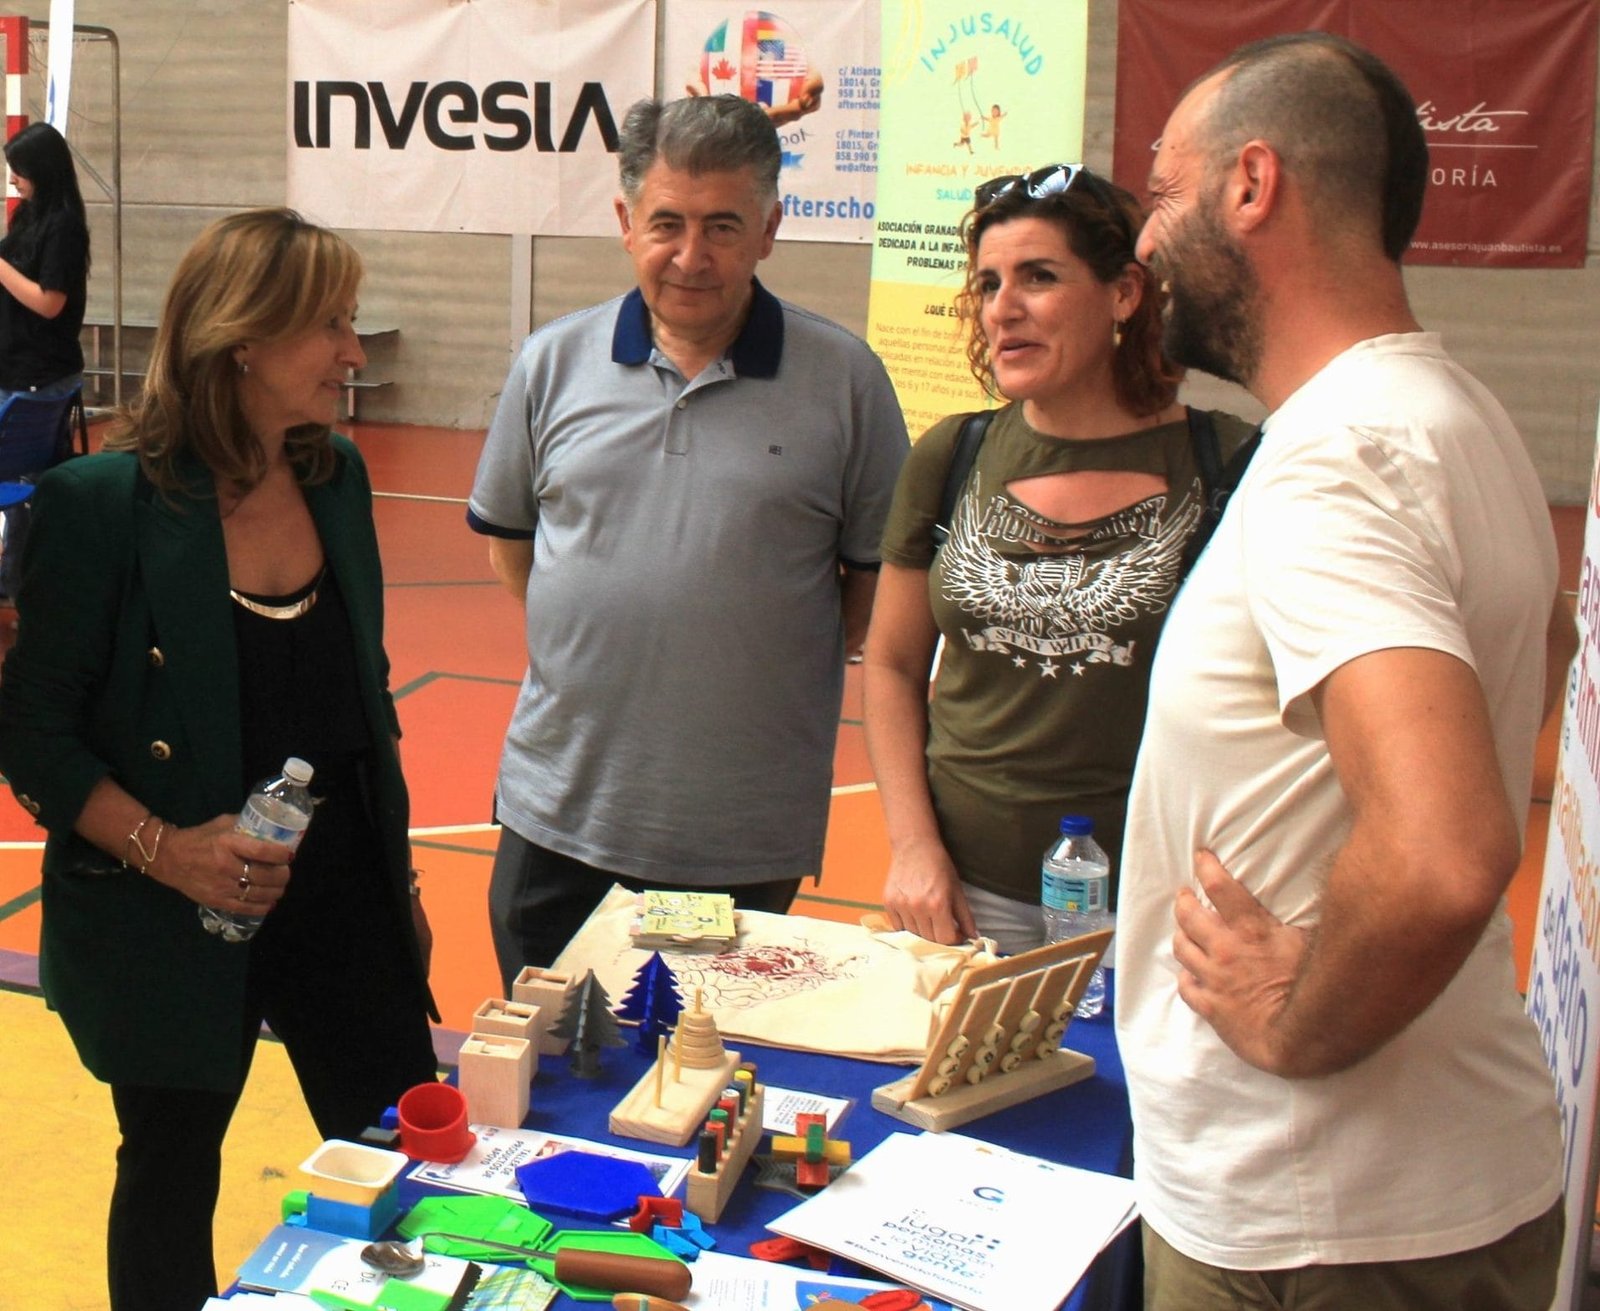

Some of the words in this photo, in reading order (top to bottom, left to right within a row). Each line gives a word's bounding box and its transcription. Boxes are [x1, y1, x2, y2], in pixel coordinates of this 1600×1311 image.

[920, 12, 1042, 75] INJUSALUD
[838, 88, 854, 98] 958
[906, 164, 957, 177] INFANCIA
[962, 164, 969, 177] Y
[1432, 164, 1497, 187] ORÍA
[936, 188, 972, 201] SALUD
[783, 194, 875, 219] fterscho
[878, 220, 922, 234] ASOCIACIÓN
[878, 238, 917, 250] DEDICADA
[920, 241, 926, 251] A
[928, 241, 939, 252] LA
[1410, 241, 1562, 253] ww.asesoriajuanbautista.es
[907, 256, 955, 270] PROBLEMAS
[924, 303, 945, 316] ¿QUÉ
[900, 1215, 983, 1246] lugar
